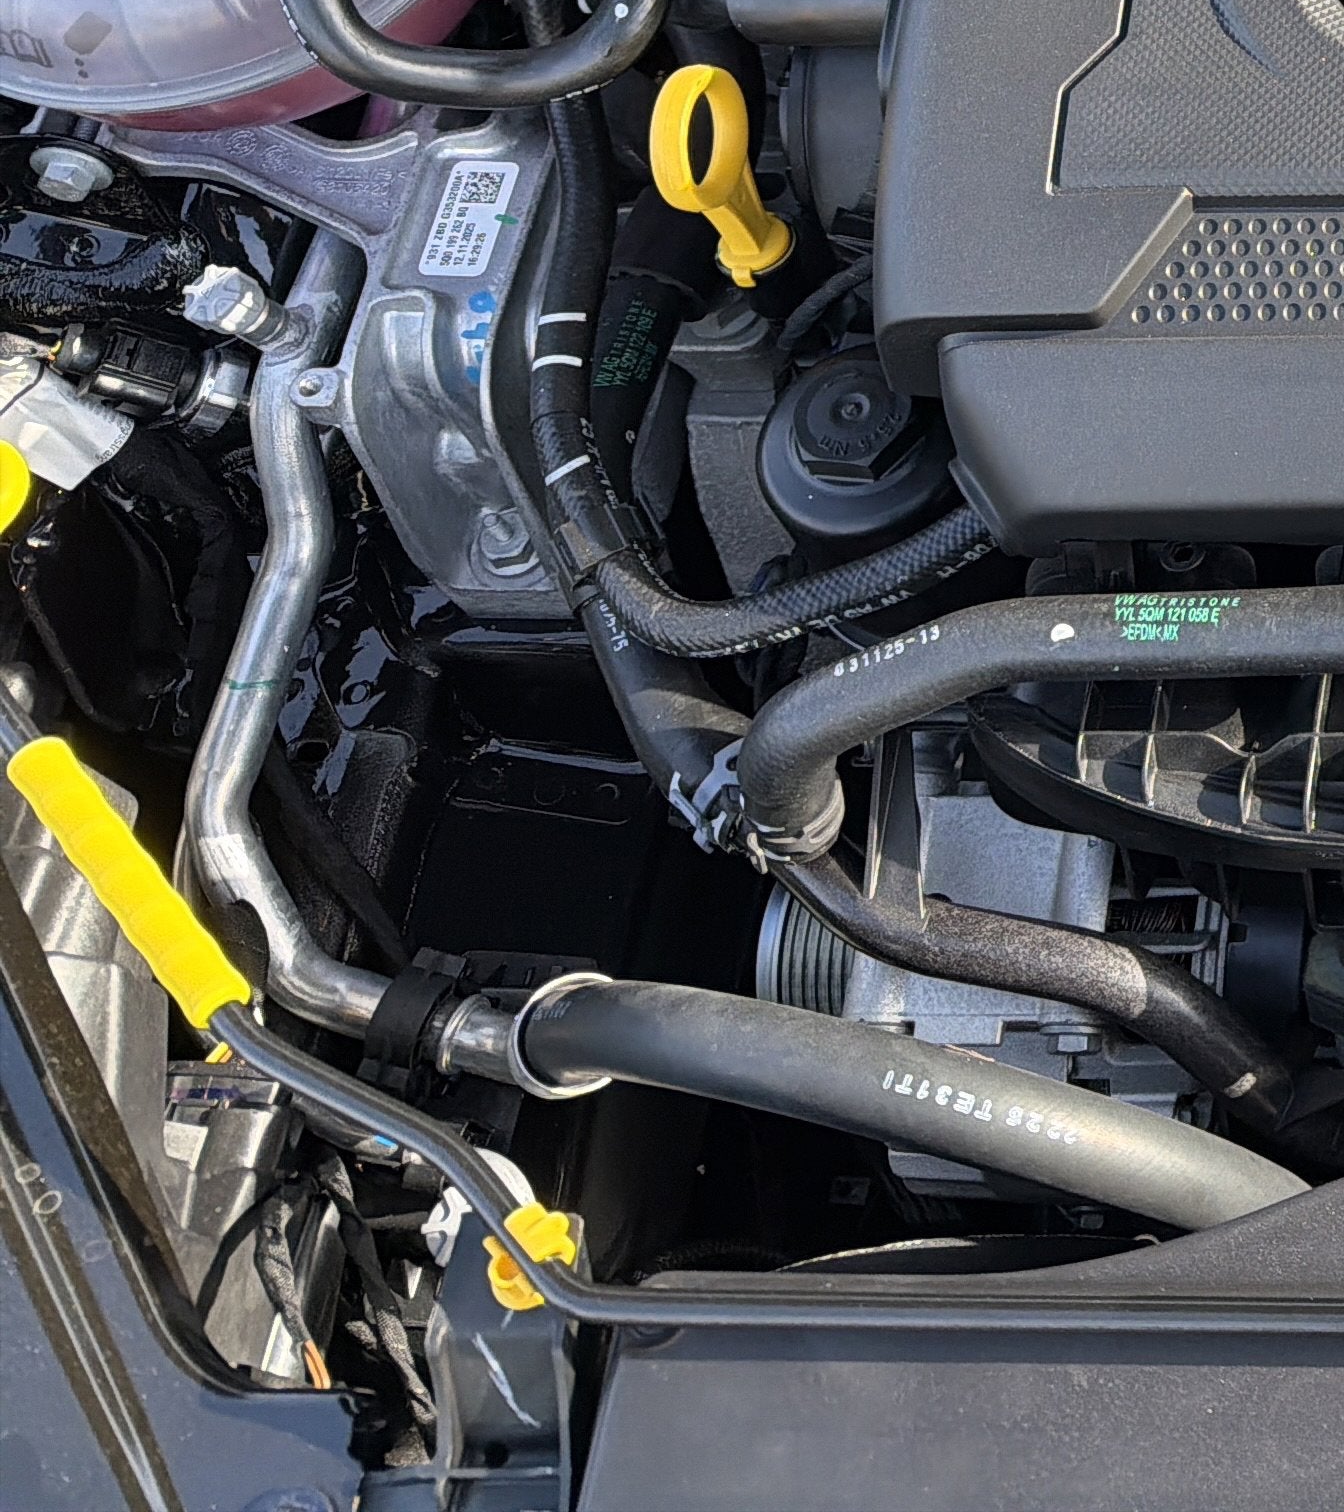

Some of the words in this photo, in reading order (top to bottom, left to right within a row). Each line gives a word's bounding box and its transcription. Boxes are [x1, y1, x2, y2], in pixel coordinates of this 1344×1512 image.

[452, 222, 476, 265] 12.11.2025
[466, 231, 487, 266] 16:29:26
[1159, 595, 1241, 607] TRISTONE
